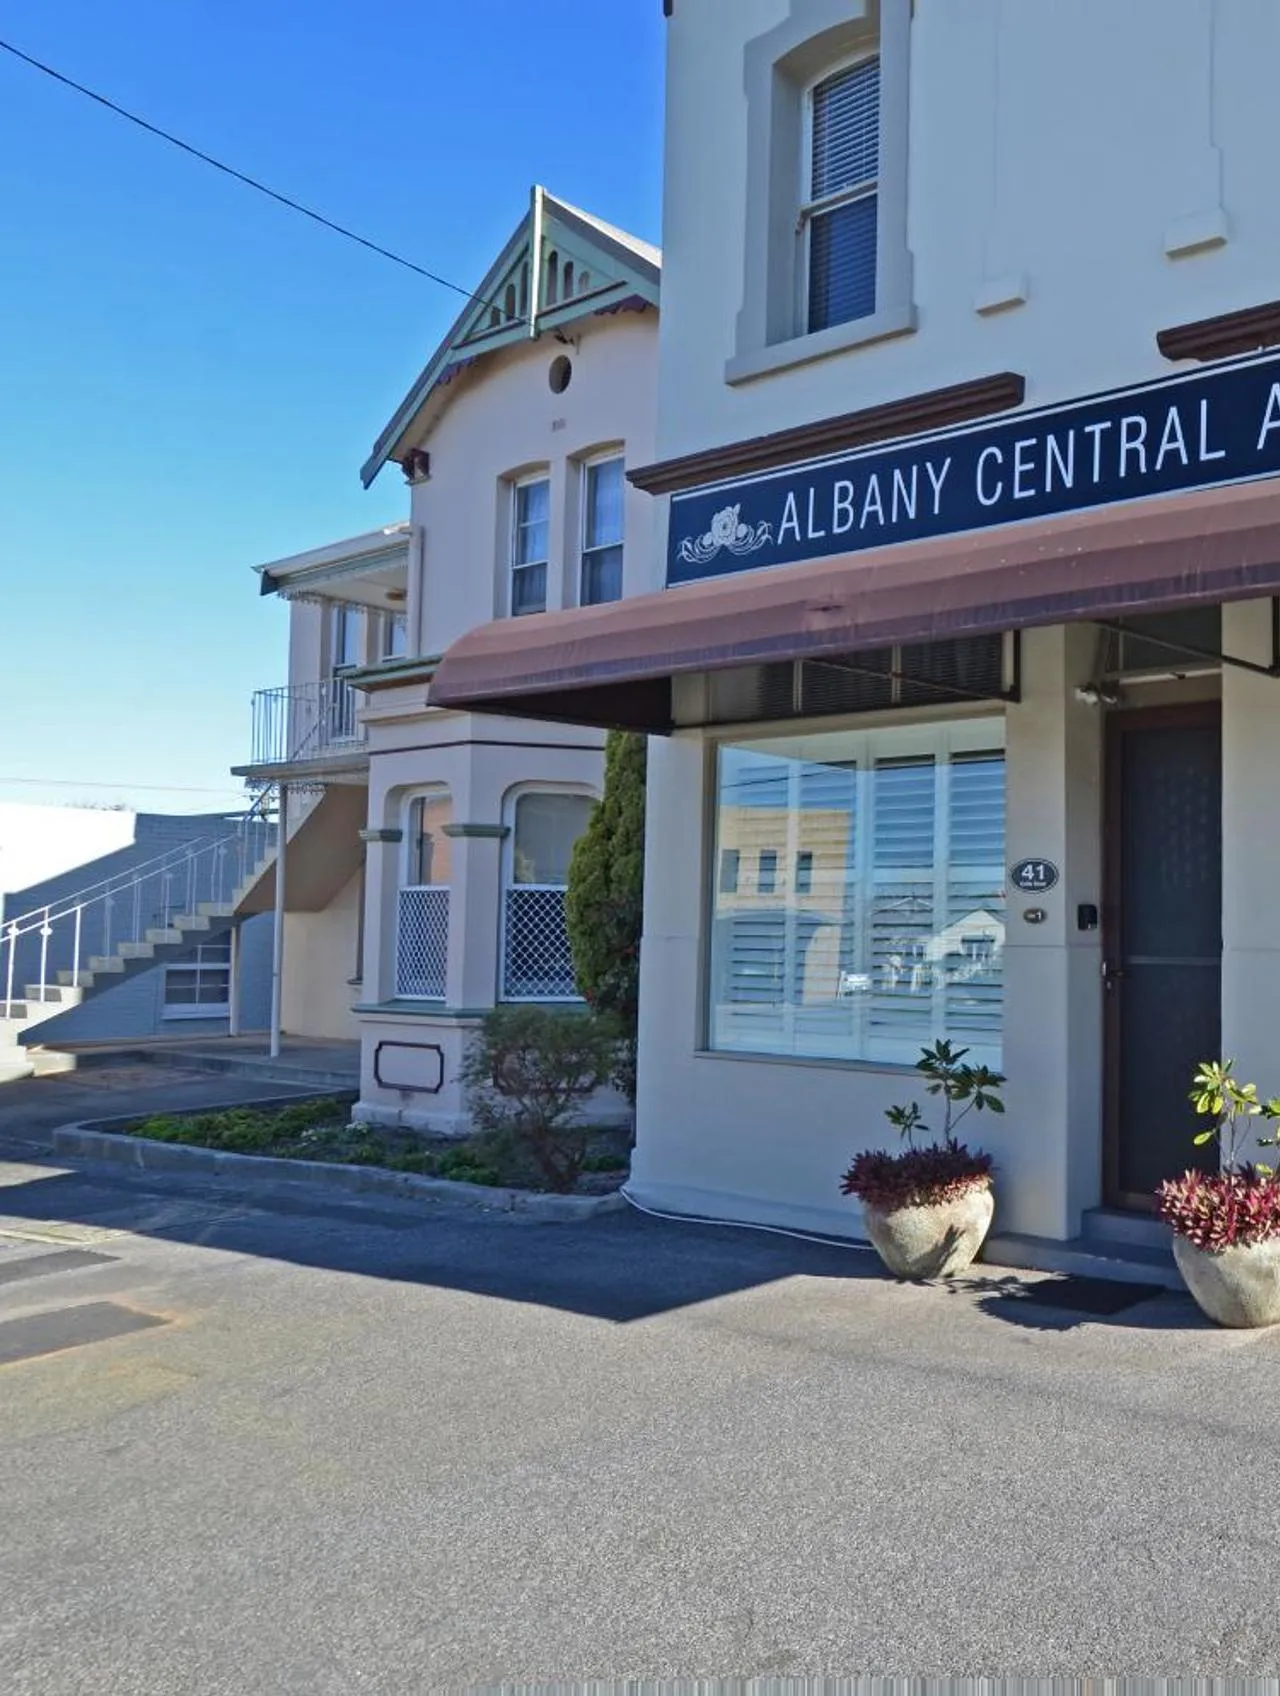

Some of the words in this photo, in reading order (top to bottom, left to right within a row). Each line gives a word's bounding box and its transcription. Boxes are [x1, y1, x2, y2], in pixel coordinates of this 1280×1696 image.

[778, 457, 952, 545] ALBANY
[975, 399, 1227, 506] CENTRAL
[1021, 864, 1045, 880] 41
